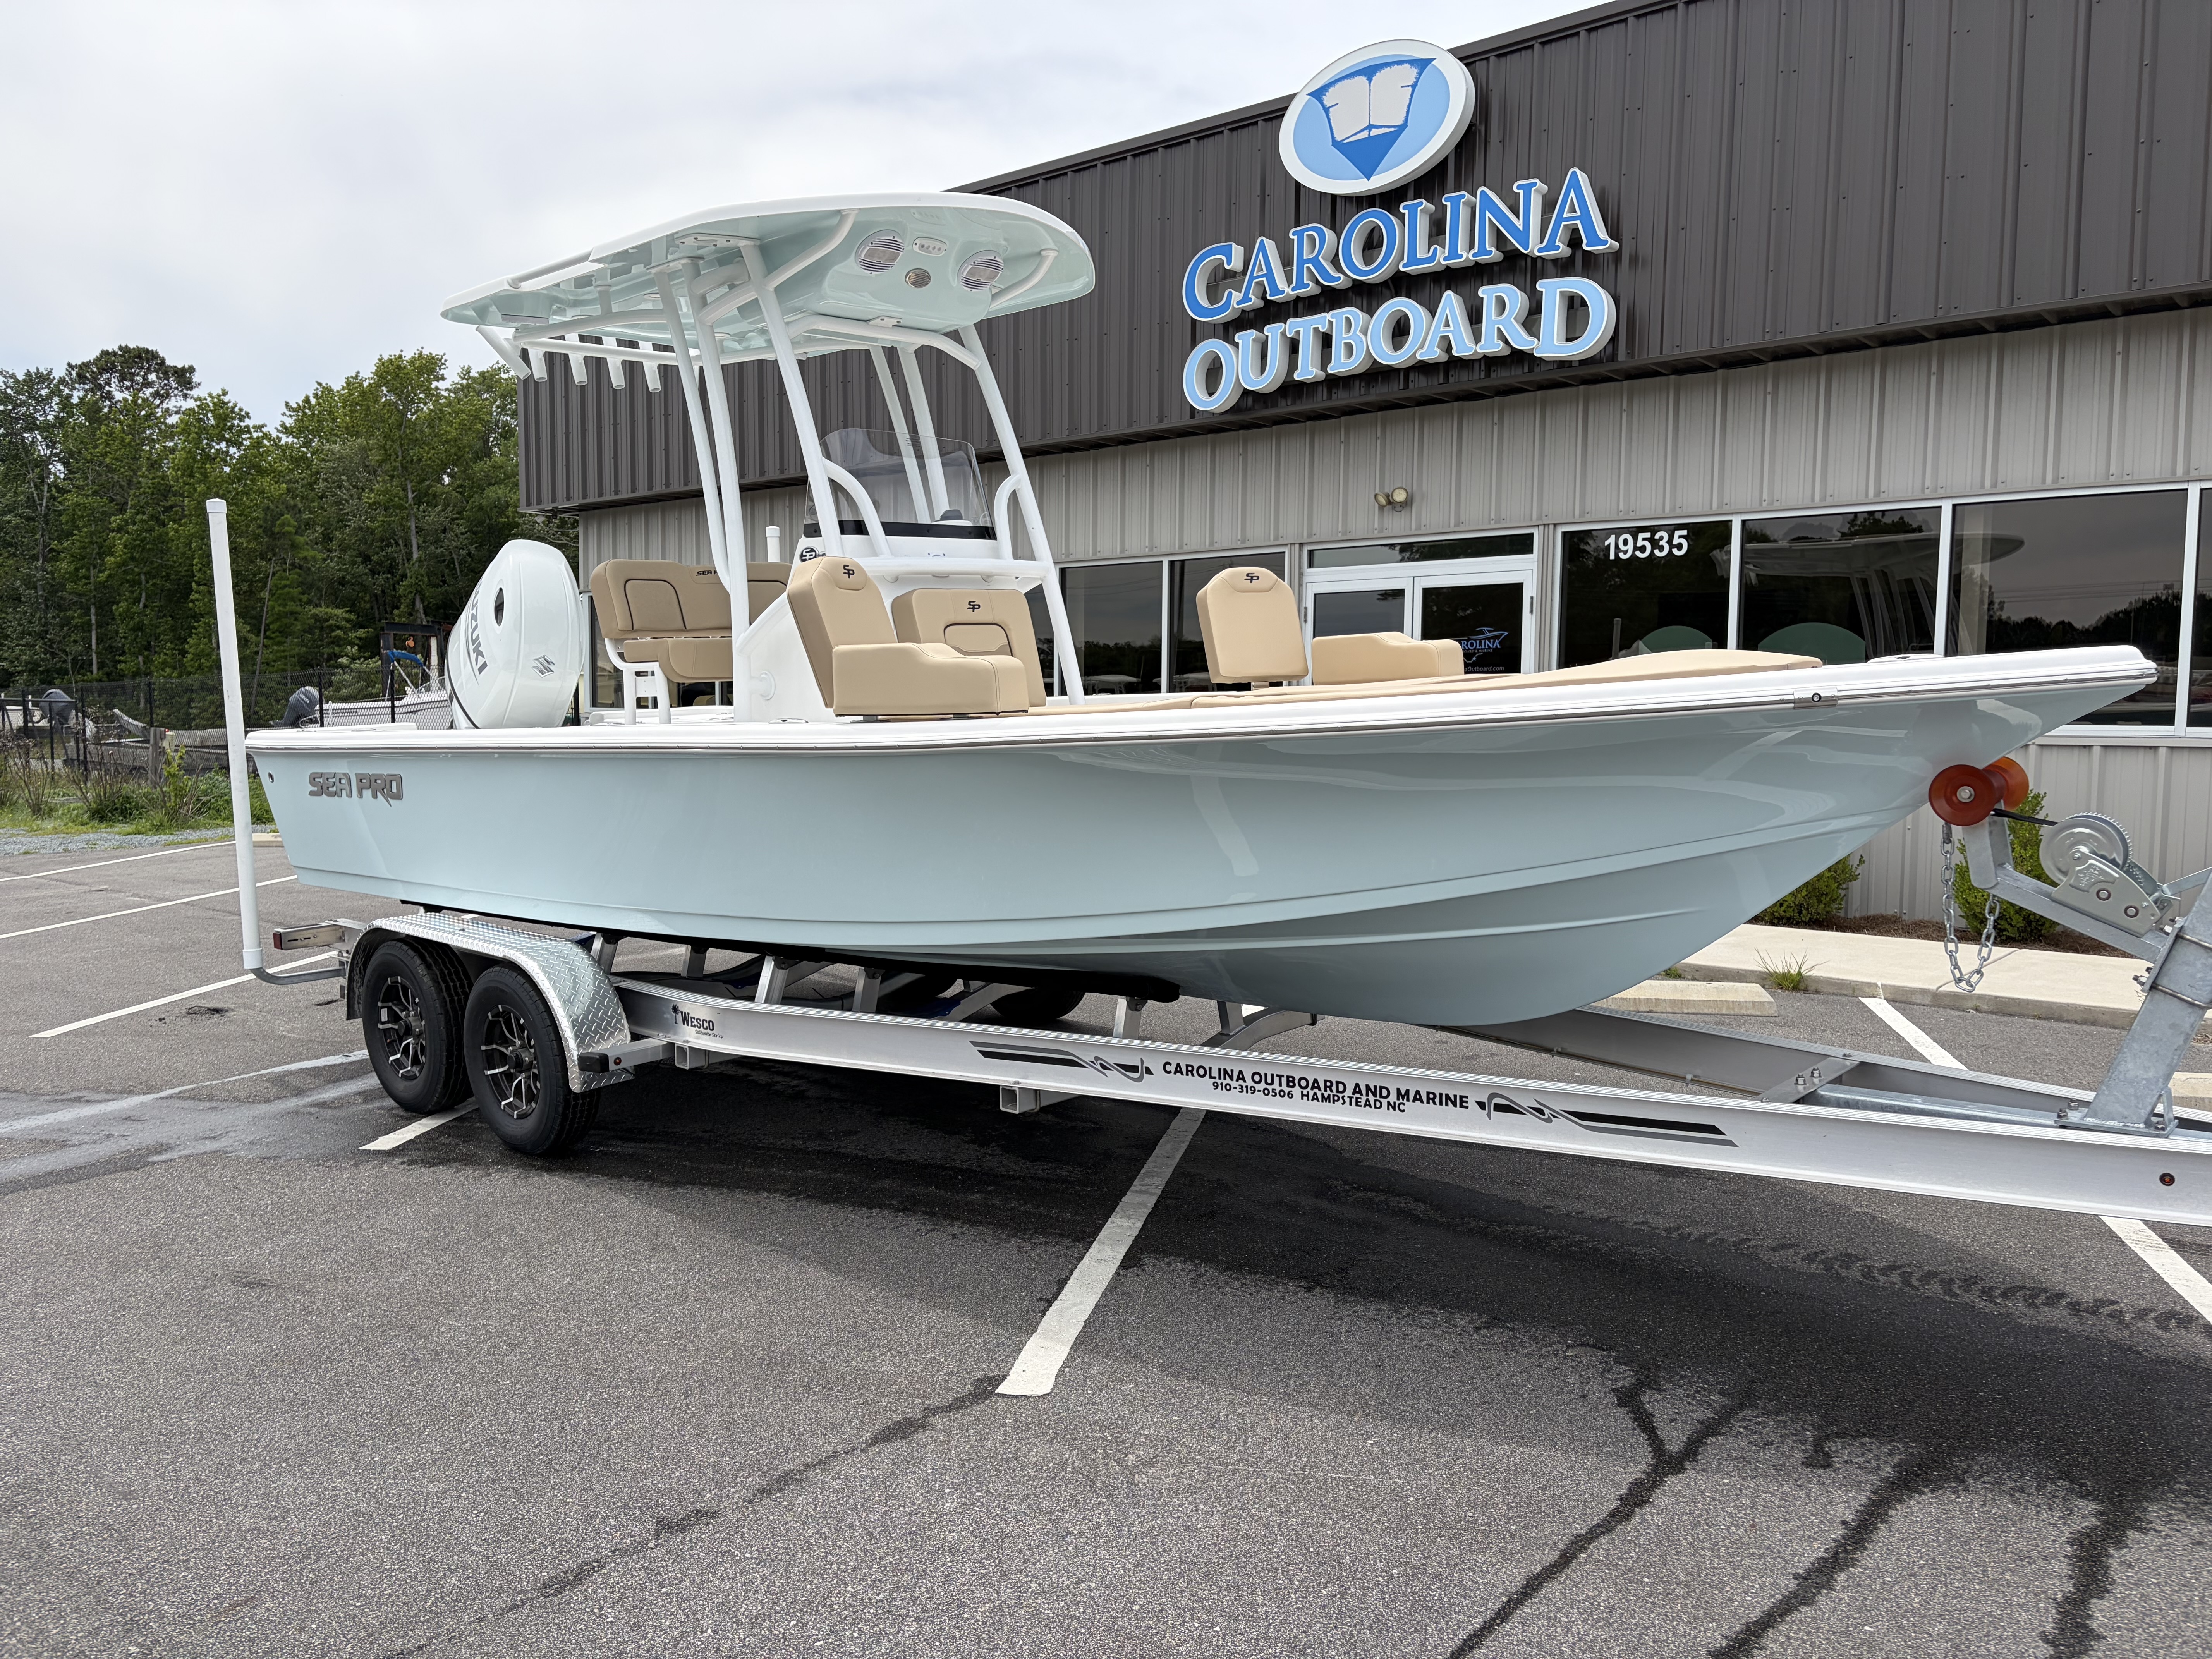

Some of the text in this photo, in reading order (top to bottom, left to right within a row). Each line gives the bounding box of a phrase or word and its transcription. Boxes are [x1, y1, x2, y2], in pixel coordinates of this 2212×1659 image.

[1183, 167, 1619, 323] CAROLINA
[1183, 277, 1616, 412] OUTBOARD
[1604, 529, 1688, 560] 19535
[842, 564, 855, 579] SP
[1244, 572, 1260, 584] SP
[967, 600, 981, 612] SP
[1461, 639, 1501, 649] ROLINA
[308, 772, 403, 807] SEA PRO
[1163, 1061, 1469, 1109] CAROLINA OUTBOARD AND MARINE
[1212, 1081, 1406, 1113] 910-319-0506 HAMPSTEAD NC
